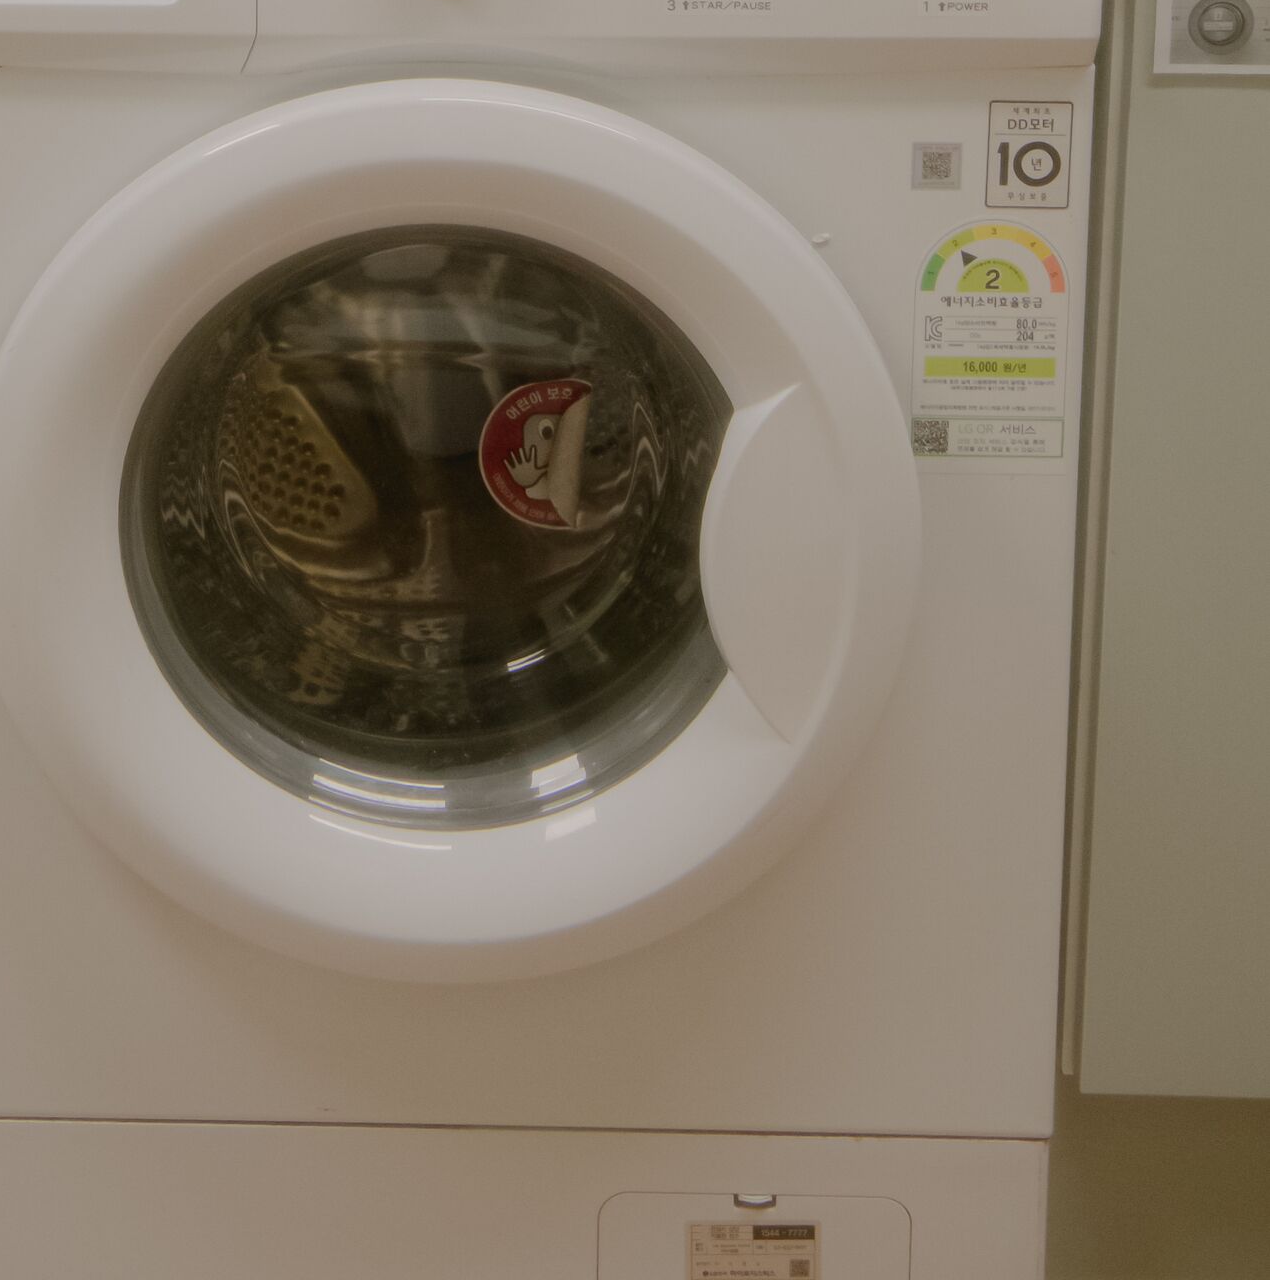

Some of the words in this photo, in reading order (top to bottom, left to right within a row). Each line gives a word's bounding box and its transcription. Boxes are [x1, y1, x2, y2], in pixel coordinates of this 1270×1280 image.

[667, 0, 676, 11] 3
[691, 0, 771, 11] STAR/PAUSE
[923, 2, 929, 12] 1
[947, 2, 989, 12] POWER
[1007, 118, 1055, 132] DD모터
[997, 141, 1062, 187] 10
[1031, 157, 1043, 171] 년
[985, 268, 1001, 290] 2
[940, 296, 1043, 309] 에너지소비효율등급
[1016, 319, 1037, 330] 80.0
[1016, 331, 1034, 342] 204
[963, 361, 998, 374] 16,000
[1003, 362, 1027, 373] 원/년
[505, 391, 543, 420] 어린이
[547, 387, 573, 400] 보호
[958, 424, 973, 434] LG
[1000, 424, 1037, 435] 서비스
